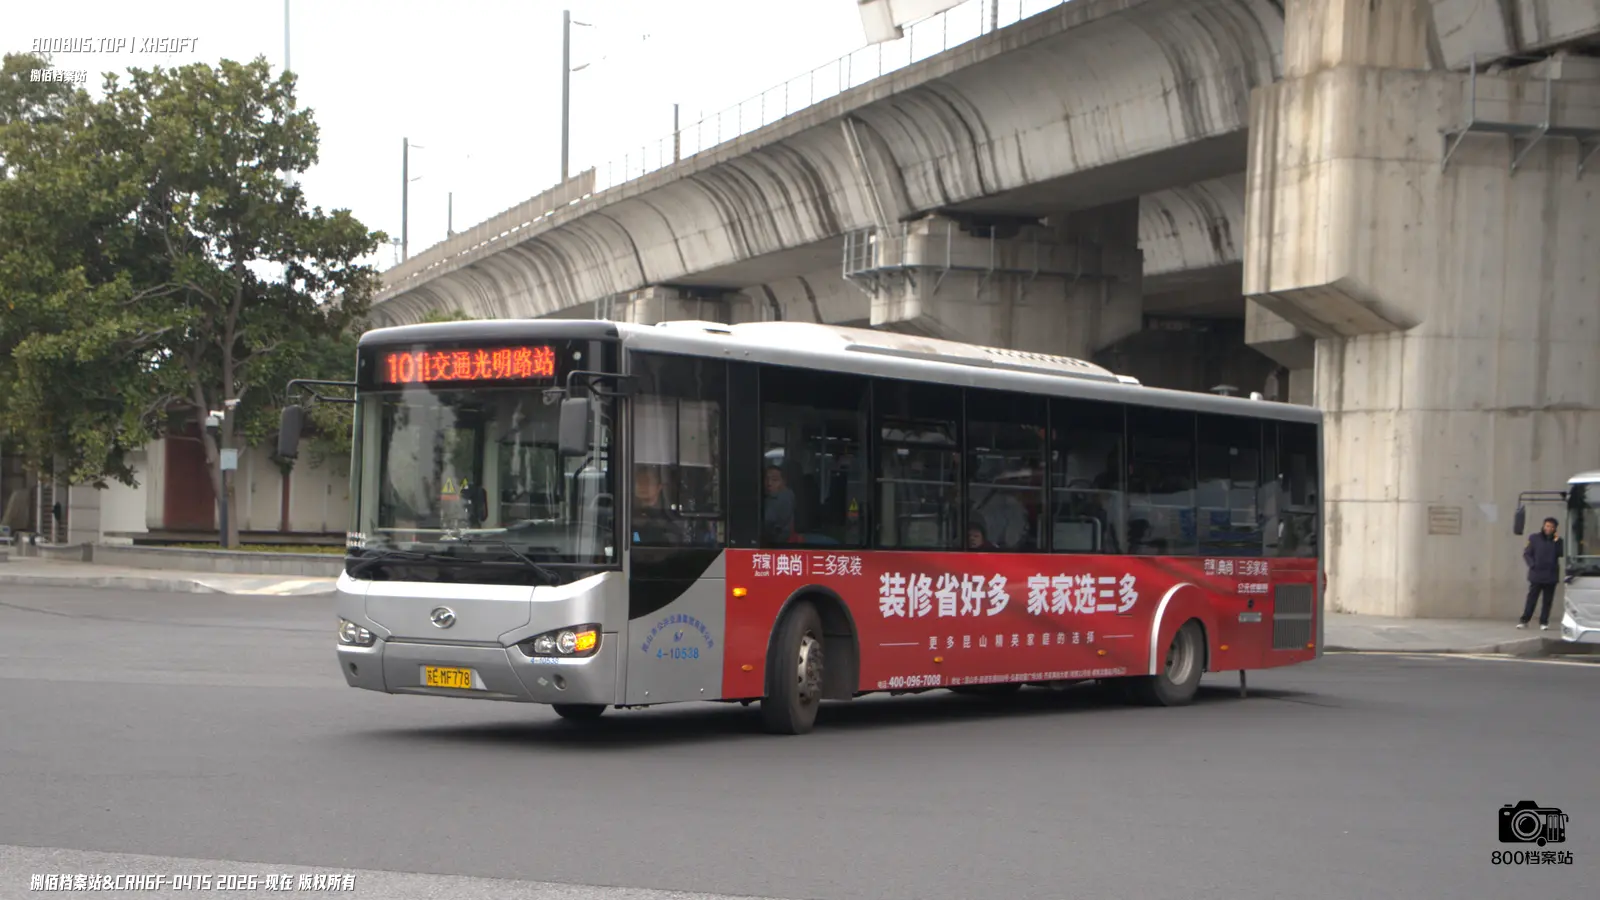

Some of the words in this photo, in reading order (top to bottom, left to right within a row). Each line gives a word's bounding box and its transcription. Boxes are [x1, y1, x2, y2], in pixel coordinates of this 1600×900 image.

[776, 554, 802, 576] 典尚
[812, 555, 862, 576] 三多家装
[1238, 560, 1268, 576] 三多家装
[879, 572, 1010, 618] 装修省好多
[1027, 573, 1139, 616] 家家选三多
[929, 630, 1096, 650] 更多昆山精英家庭的选择
[656, 647, 700, 660] 4-10538
[889, 674, 941, 688] 400-096-7008
